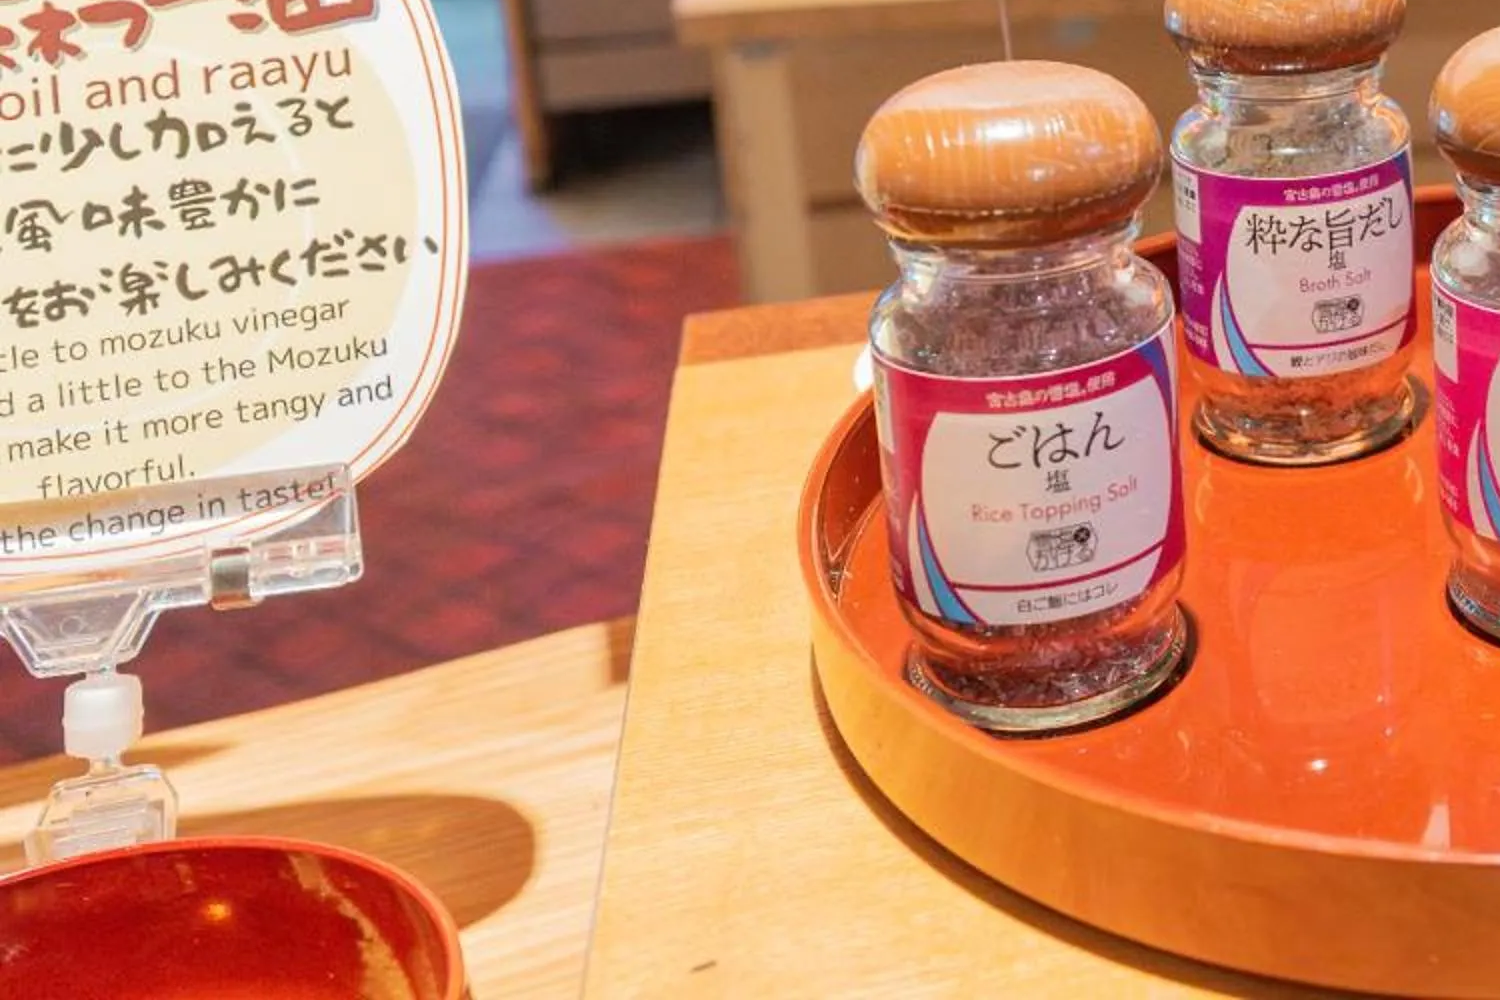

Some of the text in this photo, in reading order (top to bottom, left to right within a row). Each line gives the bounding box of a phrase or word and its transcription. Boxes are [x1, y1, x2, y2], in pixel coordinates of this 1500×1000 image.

[0, 47, 353, 121] oil and raayu
[5, 178, 321, 252] 風味豊かに
[1246, 197, 1401, 254] 粋な旨だし
[2, 229, 438, 328] をお楽しみください
[1299, 267, 1372, 294] Broth Salt
[1328, 251, 1347, 270] 塩
[53, 339, 88, 363] to
[100, 316, 221, 356] mozuku
[232, 298, 350, 333] vinegar
[28, 392, 45, 413] a
[58, 373, 142, 408] little
[154, 367, 190, 392] to
[200, 356, 257, 384] the
[268, 337, 389, 374] Mozuku
[8, 376, 394, 462] make it more tangy and
[987, 411, 1125, 469] ごはん
[37, 453, 196, 500] flavorful.
[971, 475, 1138, 524] Rice Topping Salt
[1045, 469, 1071, 493] 塩
[1, 524, 57, 554] the
[68, 503, 186, 541] change
[197, 493, 226, 518] in
